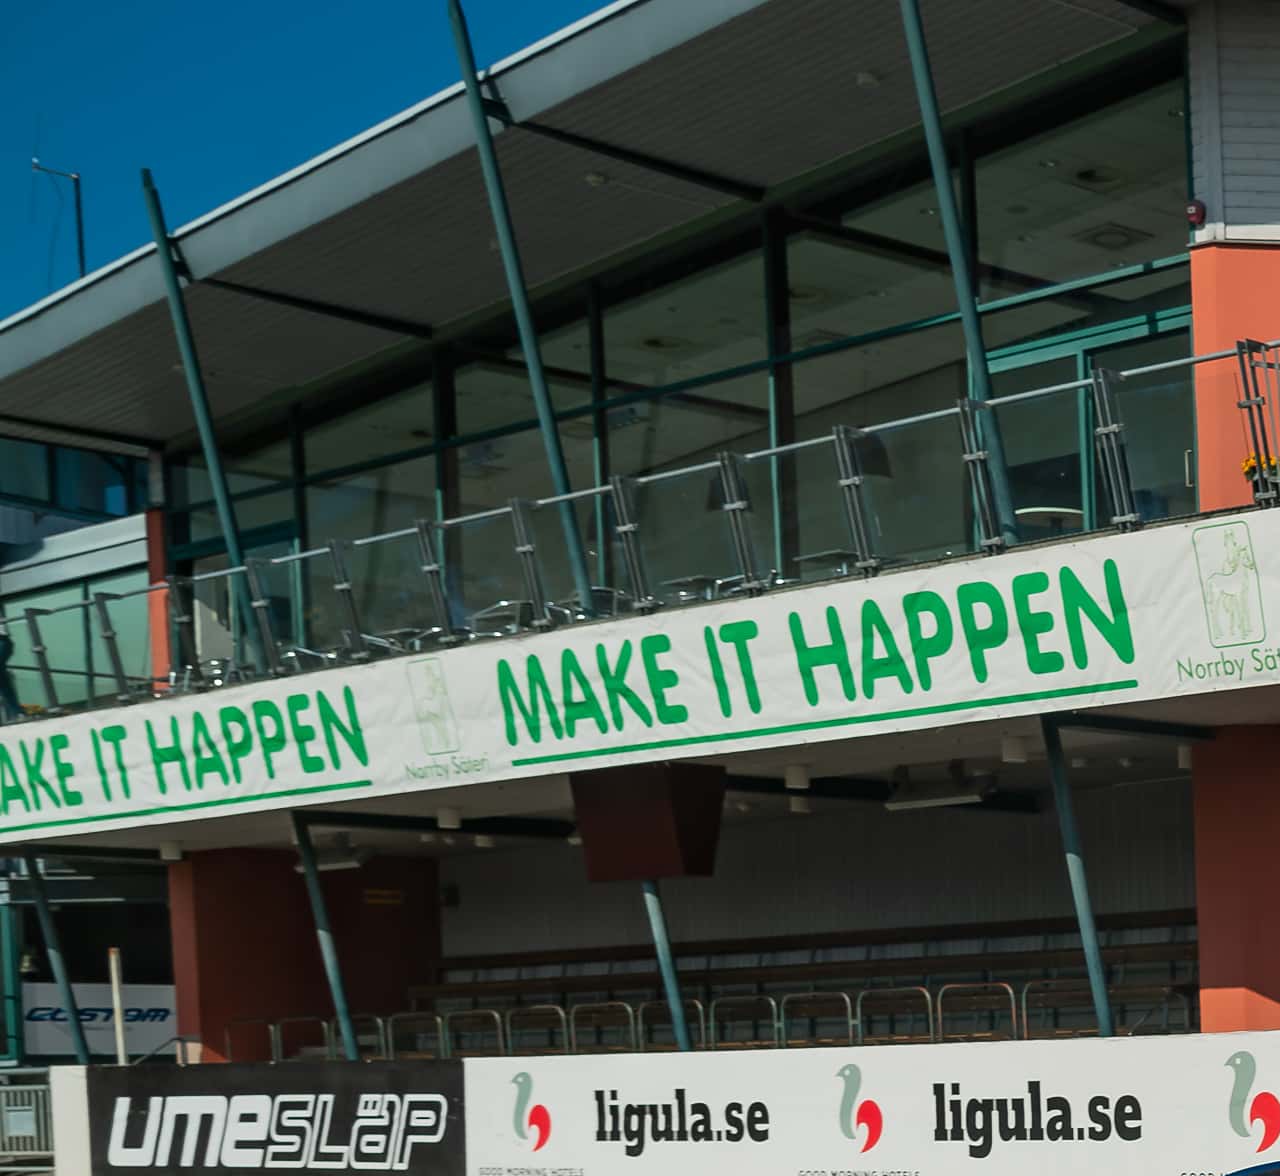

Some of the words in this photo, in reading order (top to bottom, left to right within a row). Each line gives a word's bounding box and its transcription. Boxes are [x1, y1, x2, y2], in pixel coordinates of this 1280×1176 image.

[496, 633, 690, 748] MAKE
[703, 619, 763, 719] IT
[787, 558, 1137, 708] HAPPEN
[1176, 651, 1245, 681] Norrby
[0, 732, 84, 816] AKE
[89, 724, 132, 802] IT
[144, 685, 369, 796] HAPPEN
[594, 1088, 770, 1158] ligula.se
[932, 1080, 1142, 1159] ligula.se
